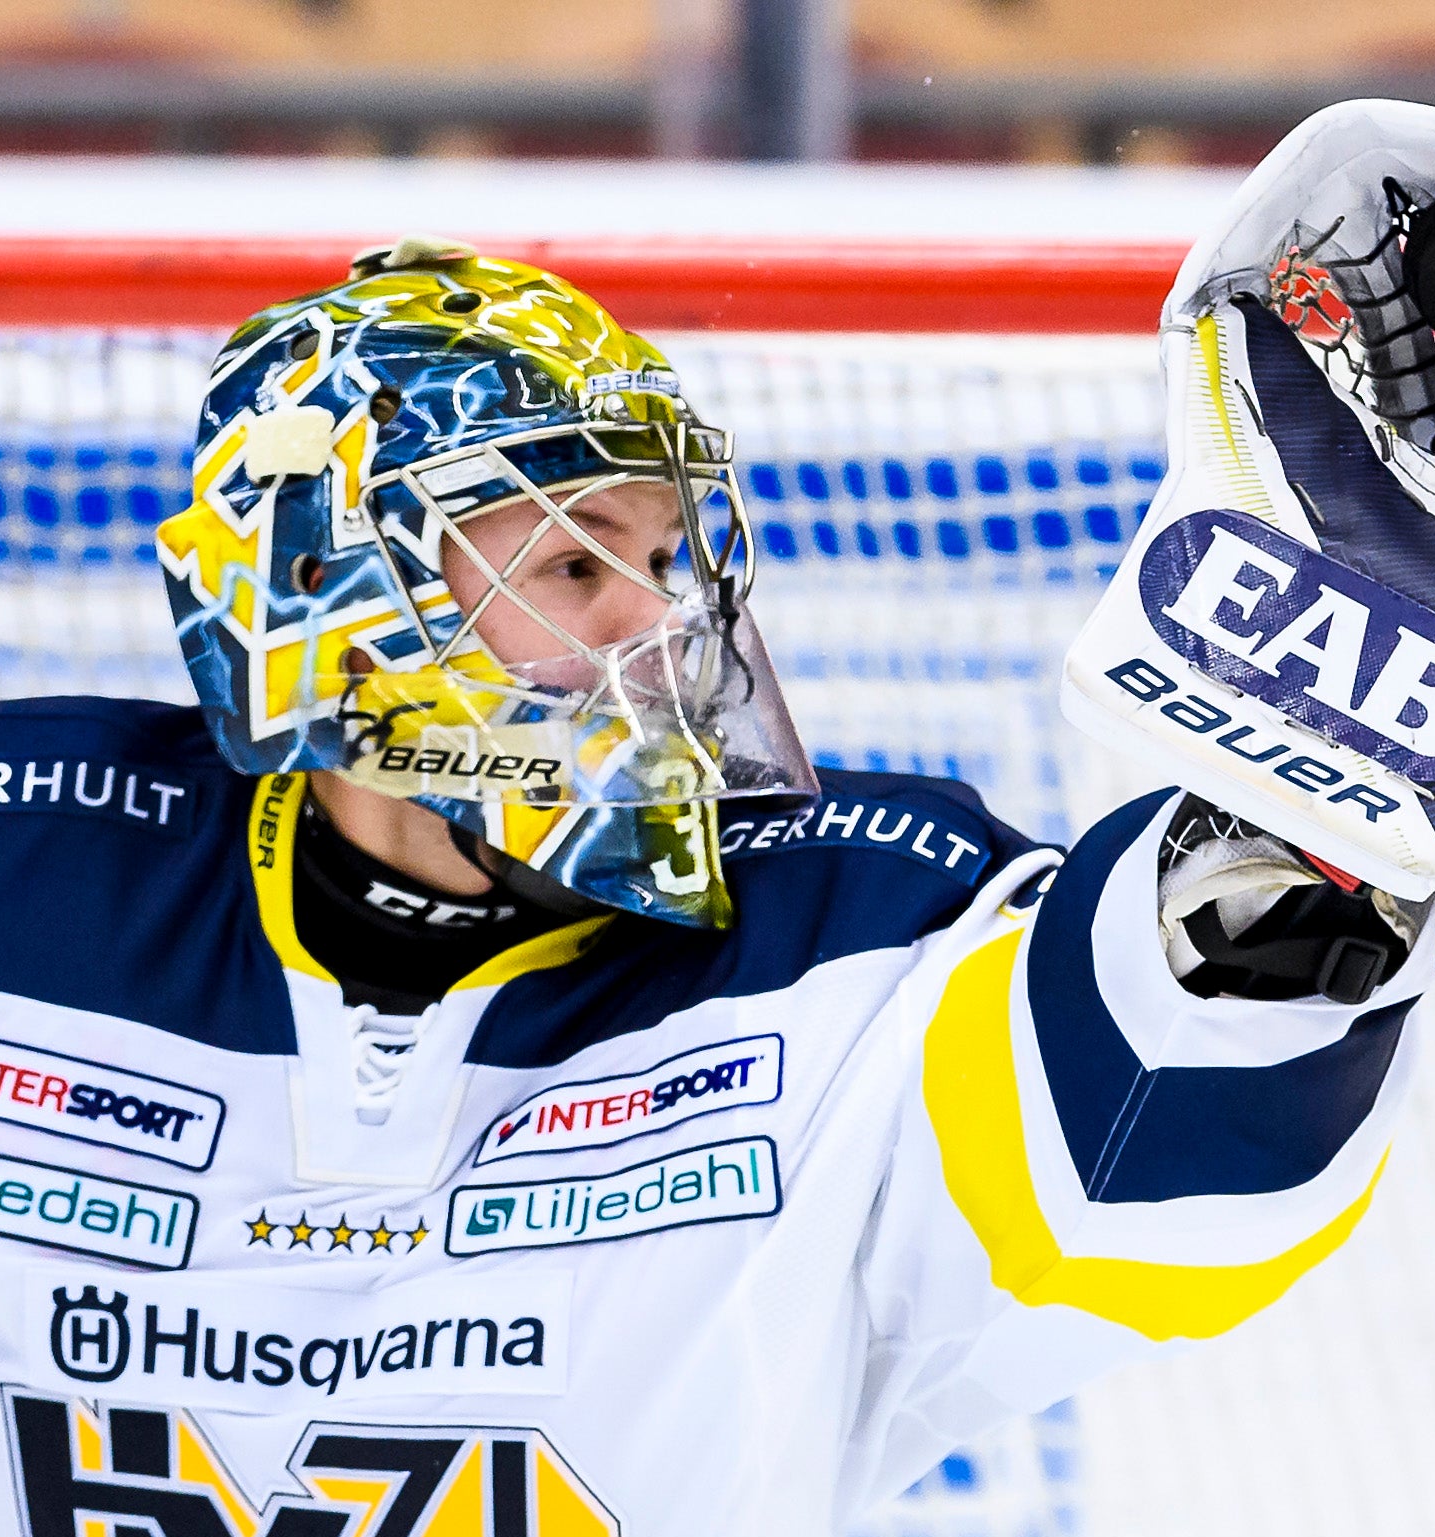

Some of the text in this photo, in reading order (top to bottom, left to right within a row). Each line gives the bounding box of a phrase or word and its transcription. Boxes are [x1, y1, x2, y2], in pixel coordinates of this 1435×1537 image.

[591, 372, 681, 396] BAU
[378, 748, 561, 785] BAUER
[1103, 657, 1402, 824] BAUER
[257, 773, 295, 870] AUER
[720, 800, 980, 870] GERHULT
[536, 1055, 766, 1136] INTERSPORT
[524, 1147, 764, 1236] Liljedahl
[142, 1305, 546, 1396] Husqvarna
